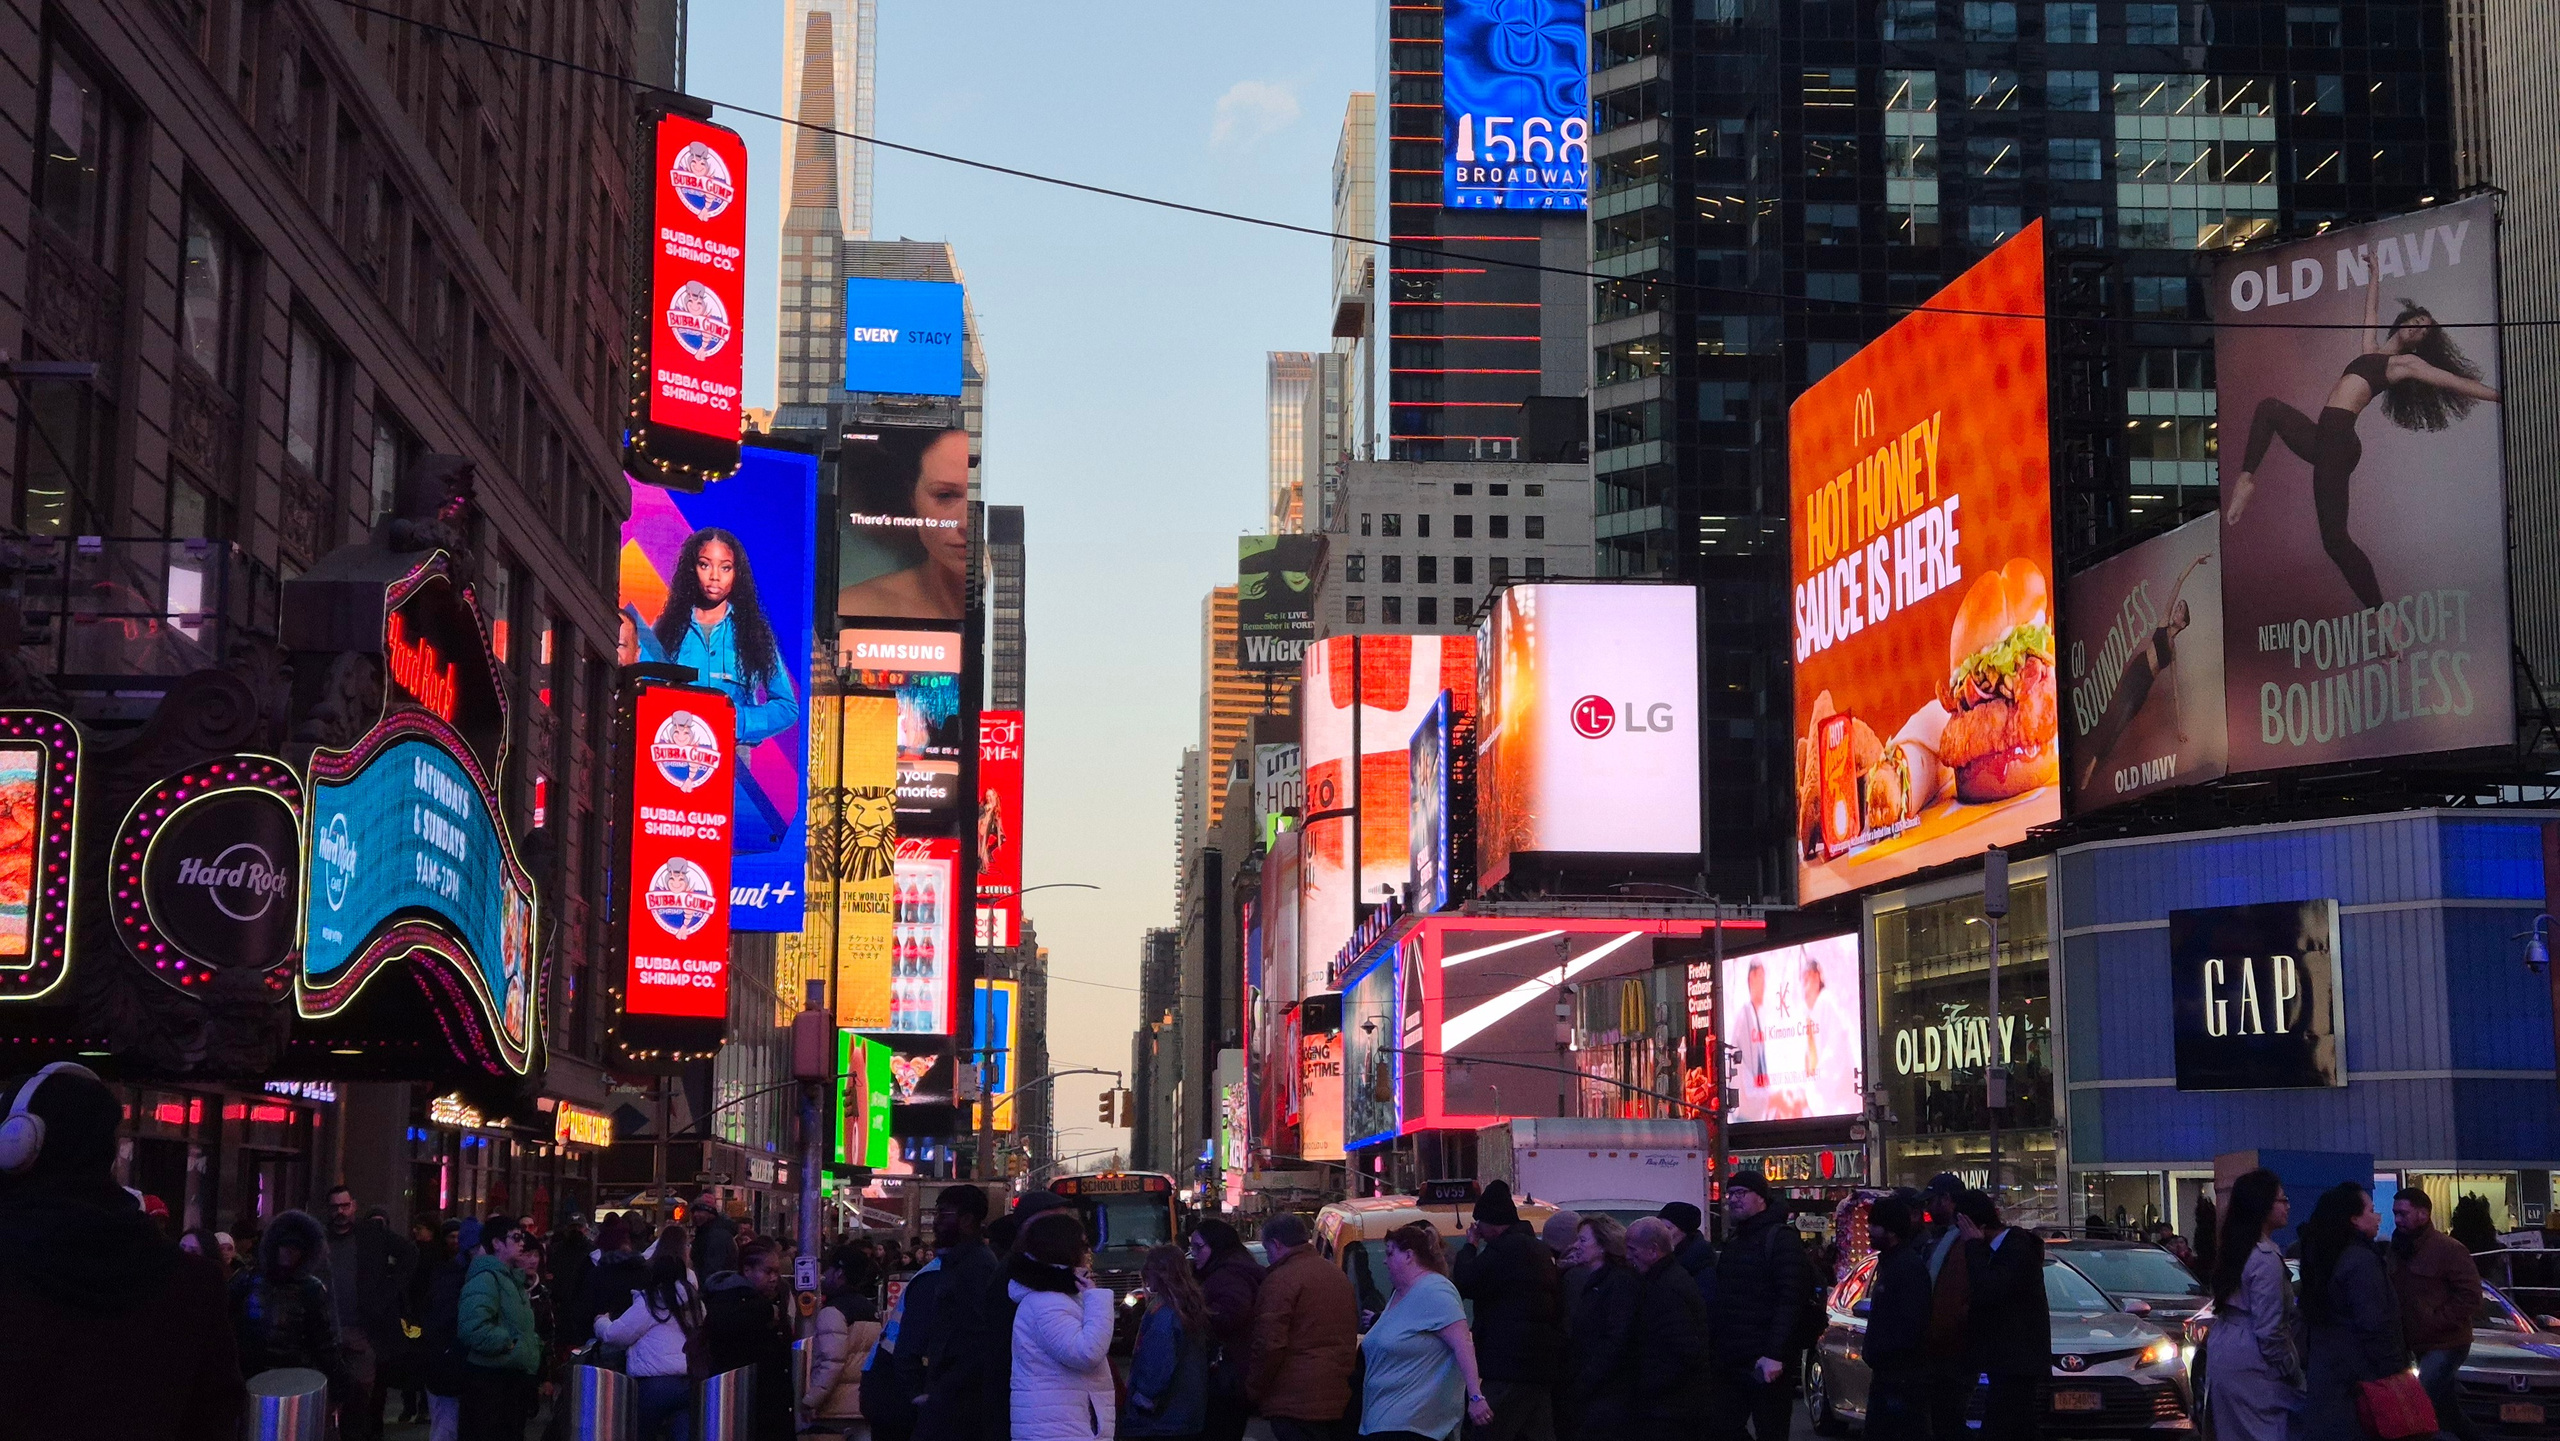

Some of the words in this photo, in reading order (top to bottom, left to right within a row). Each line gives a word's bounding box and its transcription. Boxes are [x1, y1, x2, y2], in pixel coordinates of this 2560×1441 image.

[672, 171, 704, 190] BUBBA
[705, 179, 732, 199] GUMP
[1456, 167, 1588, 183] BROADWAY
[1456, 195, 1503, 206] NEW
[1528, 196, 1588, 207] YORK
[661, 227, 703, 250] BUBBA
[704, 239, 740, 259] GUMP
[665, 242, 711, 265] SHRIMP
[713, 256, 735, 272] CO.
[2230, 257, 2324, 312] OLD
[2336, 219, 2470, 291] NAVY
[669, 312, 700, 329] BUBBA
[702, 319, 729, 339] GUMP
[854, 327, 899, 343] EVERY
[908, 331, 952, 345] STACY
[658, 369, 700, 391] BUBBA
[701, 380, 737, 398] GUMP
[662, 384, 708, 405] SHRIMP
[710, 397, 732, 412] CO.
[1807, 468, 1852, 571] HOT
[1856, 410, 1941, 543] HONEY
[850, 512, 891, 526] There's
[893, 517, 924, 527] more
[925, 517, 938, 527] to
[939, 519, 958, 528] see
[1796, 550, 1864, 664] SAUCE
[1867, 535, 1890, 626] IS
[1894, 493, 1962, 611] HERE
[1243, 622, 1282, 631] Remember
[1291, 621, 1315, 629] FORE
[2258, 622, 2291, 652] NEW
[2292, 589, 2472, 671] POWERSOFT
[857, 642, 945, 660] SAMSUNG
[2071, 640, 2087, 679] GO
[2072, 579, 2160, 736] BOUNDLESS
[2260, 651, 2475, 746] BOUNDLESS
[1625, 702, 1674, 733] LG
[1828, 721, 1845, 749] HOT
[654, 747, 687, 761] BUBBA
[690, 750, 719, 767] GUMP
[979, 745, 1019, 761] OMEN
[1267, 747, 1300, 777] LITT
[904, 770, 936, 784] your
[2114, 765, 2140, 794] OLD
[2142, 754, 2178, 786] NAVY
[414, 755, 470, 820] SATURDAYS
[640, 806, 686, 823] BUBBA
[687, 811, 727, 827] GUMP
[413, 803, 421, 835] &
[423, 807, 467, 862] SUNDAYS
[645, 821, 695, 838] SHRIMP
[697, 826, 721, 841] CO.
[177, 857, 248, 888] Hard
[247, 863, 287, 899] Rock
[415, 851, 460, 902] 9AM-2PM
[649, 893, 682, 908] BUBBA
[685, 894, 714, 912] GUMP
[730, 881, 796, 909] unt+
[843, 891, 857, 901] THE
[858, 892, 890, 902] WORLD'S
[852, 901, 891, 914] MUSICAL
[634, 955, 681, 972] BUBBA
[682, 959, 722, 974] GUMP
[1687, 962, 1711, 979] Freddy
[639, 971, 691, 987] SHRIMP
[692, 974, 716, 988] CO.
[1687, 981, 1713, 997] Fazbear
[1688, 997, 1712, 1012] Crunch
[2204, 955, 2297, 1038] GAP
[1691, 1015, 1710, 1030] Menu
[1769, 1025, 1795, 1040] Kimono
[1896, 1028, 1942, 1075] OLD
[1763, 1152, 1810, 1182] GIFTS
[1081, 1180, 1118, 1193] SCHOOL
[1121, 1179, 1140, 1192] BUS
[1435, 1185, 1465, 1199] 6V59
[1961, 1170, 1990, 1190] NAVY
[2527, 1209, 2541, 1219] GAP
